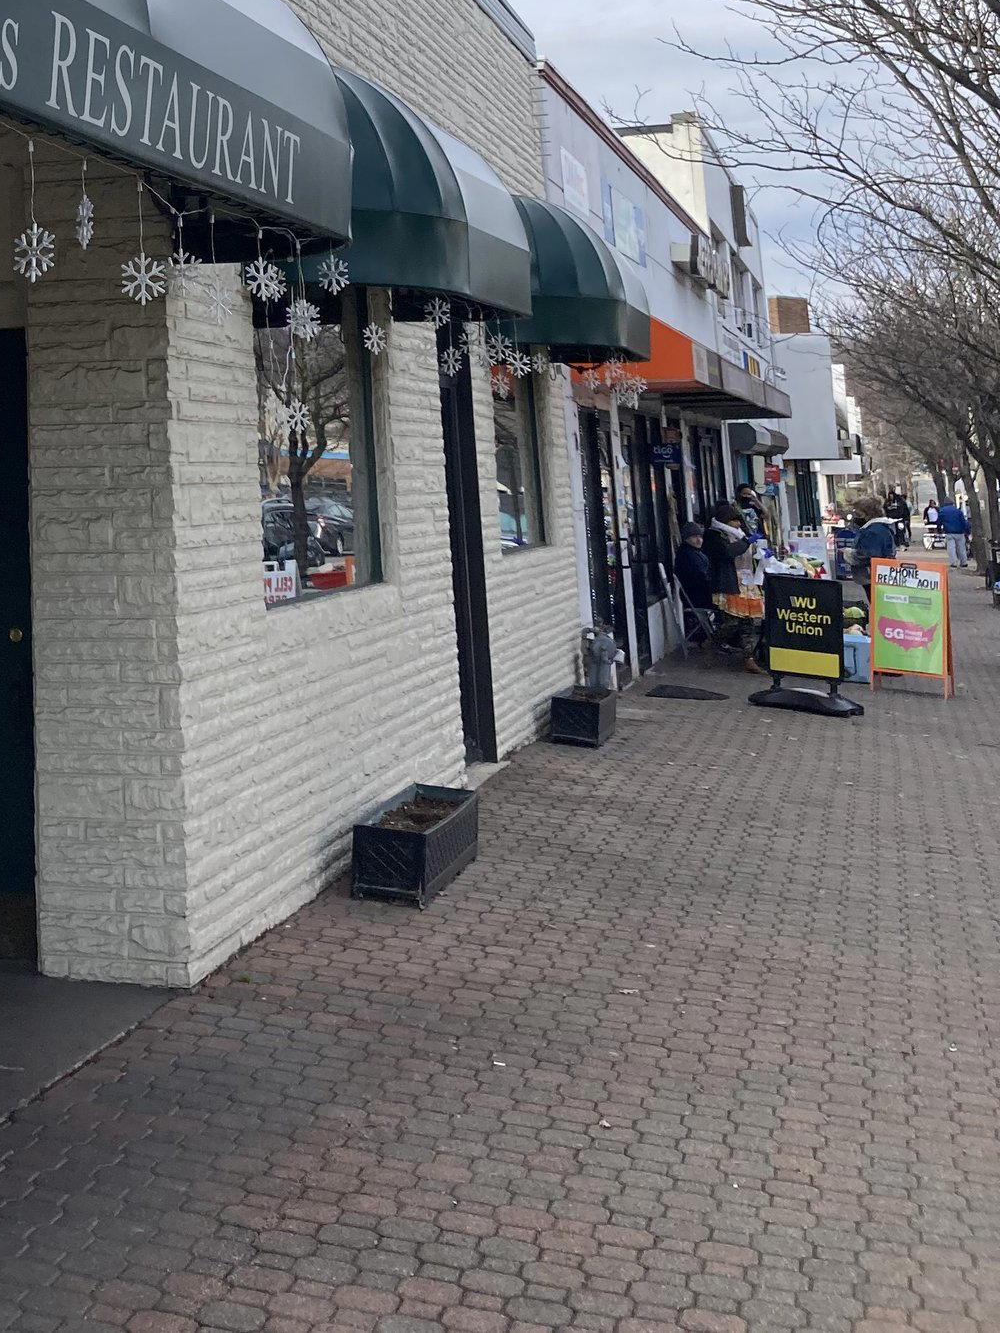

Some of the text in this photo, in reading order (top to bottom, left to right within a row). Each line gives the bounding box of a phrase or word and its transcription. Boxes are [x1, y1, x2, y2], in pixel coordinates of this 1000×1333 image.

[45, 10, 301, 204] RESTAURANT
[889, 567, 919, 579] PHONE
[877, 573, 939, 590] REPAIR AQUI
[776, 608, 831, 625] Western
[786, 621, 823, 636] Union
[884, 627, 904, 639] 5G
